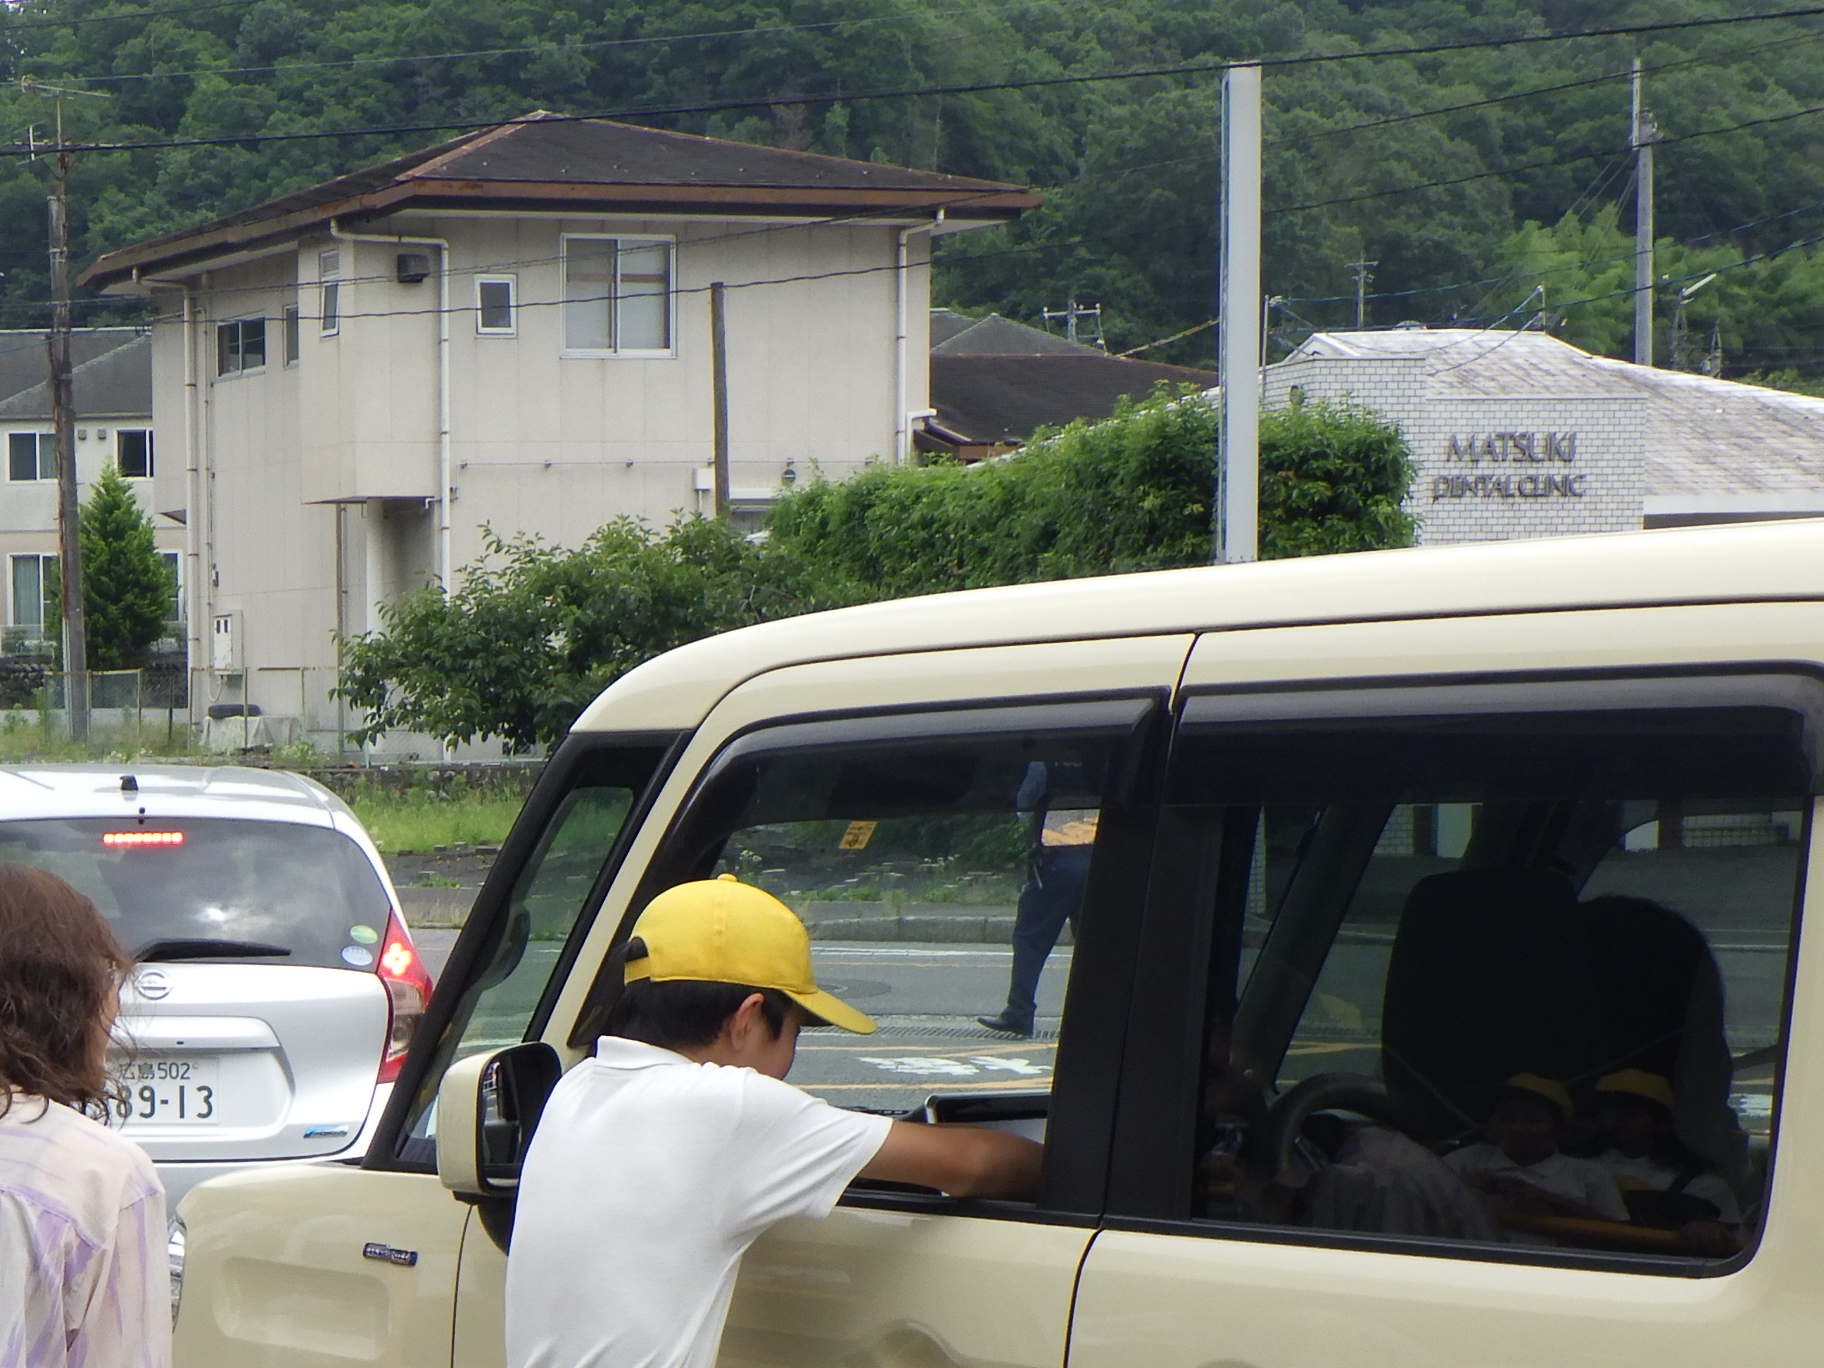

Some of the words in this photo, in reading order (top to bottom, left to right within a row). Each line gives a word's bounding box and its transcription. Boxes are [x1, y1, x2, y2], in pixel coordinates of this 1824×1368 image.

[1447, 430, 1578, 464] MATSUKI
[1433, 474, 1515, 503] DENTAL
[1516, 474, 1586, 498] CLINIC
